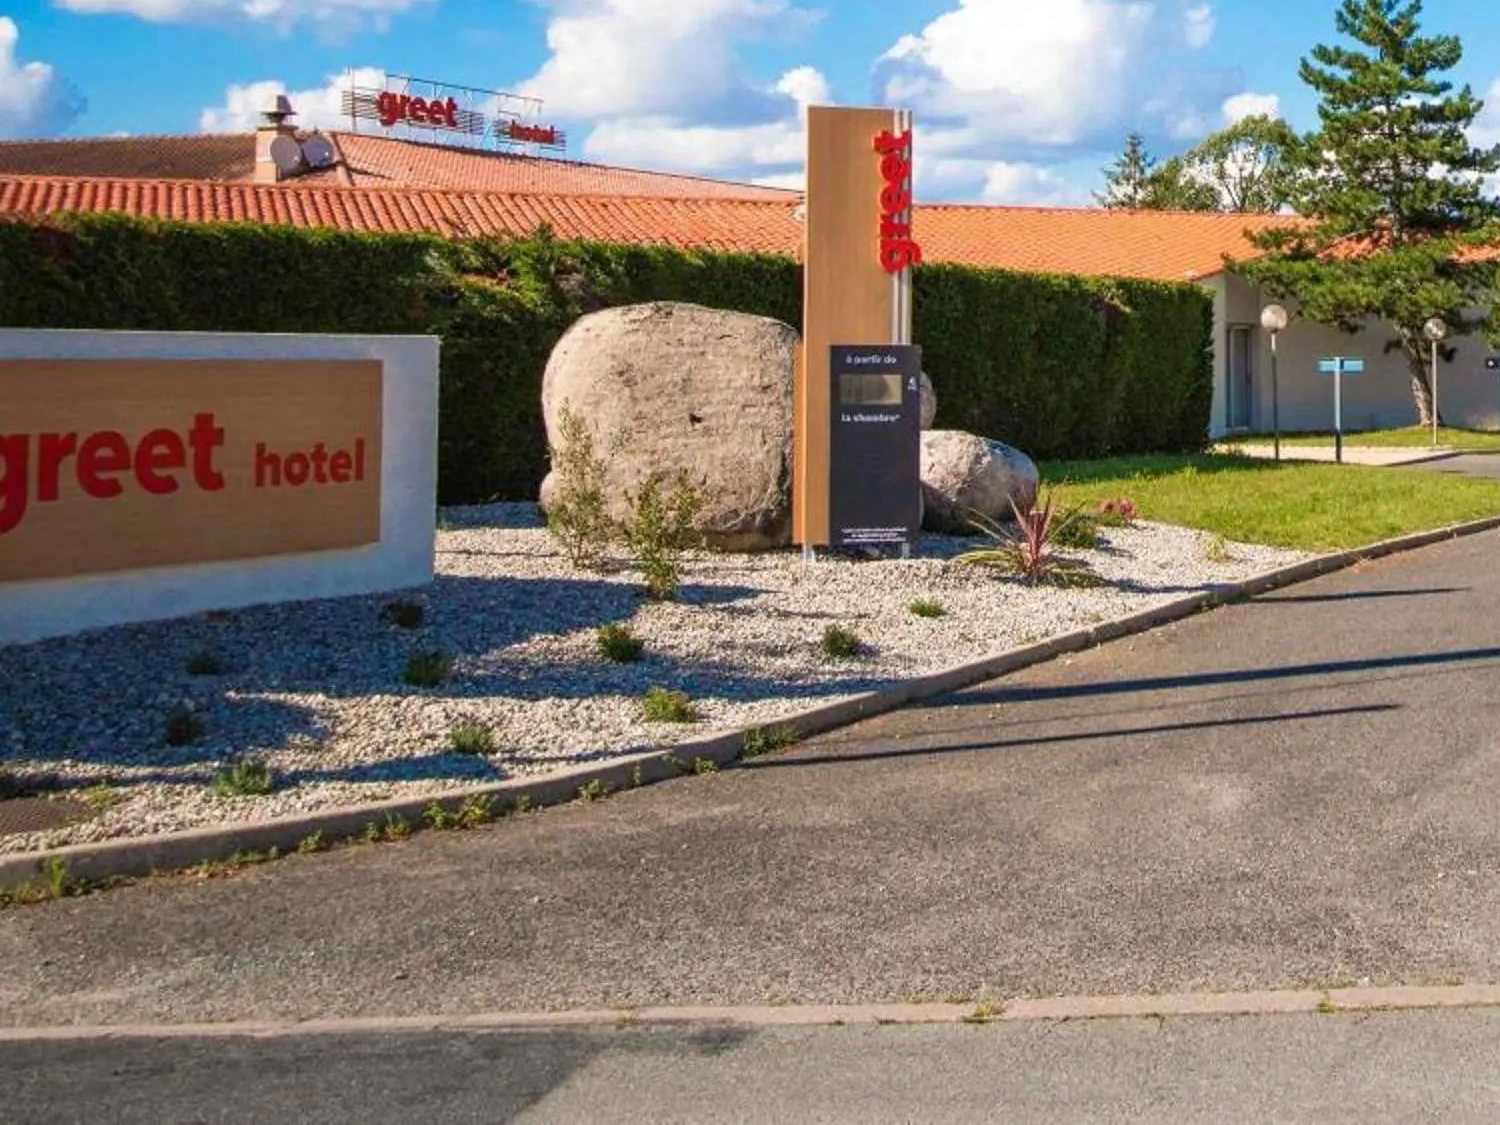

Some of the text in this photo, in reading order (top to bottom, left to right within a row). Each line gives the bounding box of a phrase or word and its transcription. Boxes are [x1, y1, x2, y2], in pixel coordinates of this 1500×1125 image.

[376, 90, 555, 144] greet hotel
[873, 130, 922, 273] greet
[255, 438, 365, 487] hotel
